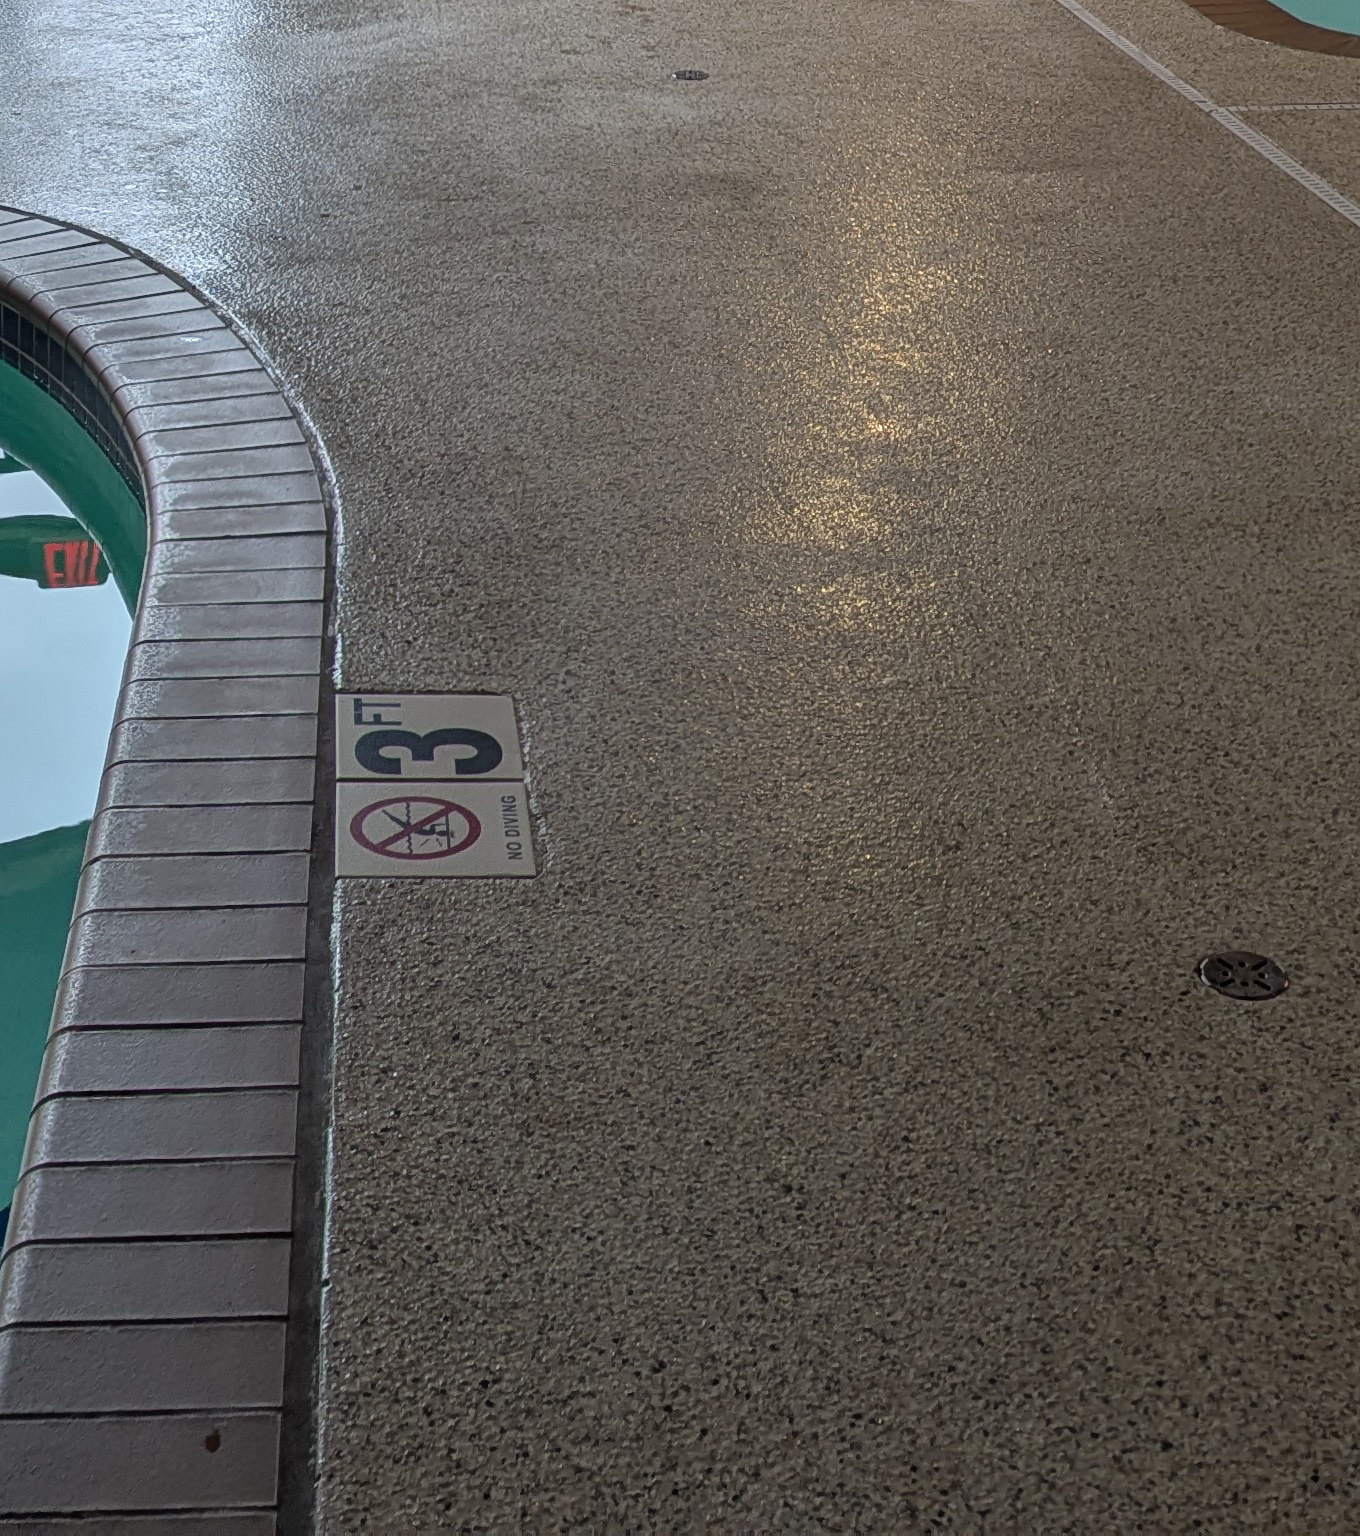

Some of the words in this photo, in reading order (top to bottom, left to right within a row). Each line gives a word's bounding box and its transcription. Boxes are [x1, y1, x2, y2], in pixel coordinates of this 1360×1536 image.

[353, 698, 402, 726] FT
[354, 727, 503, 775] 3
[501, 795, 521, 837] DIVING
[506, 842, 523, 860] NO
